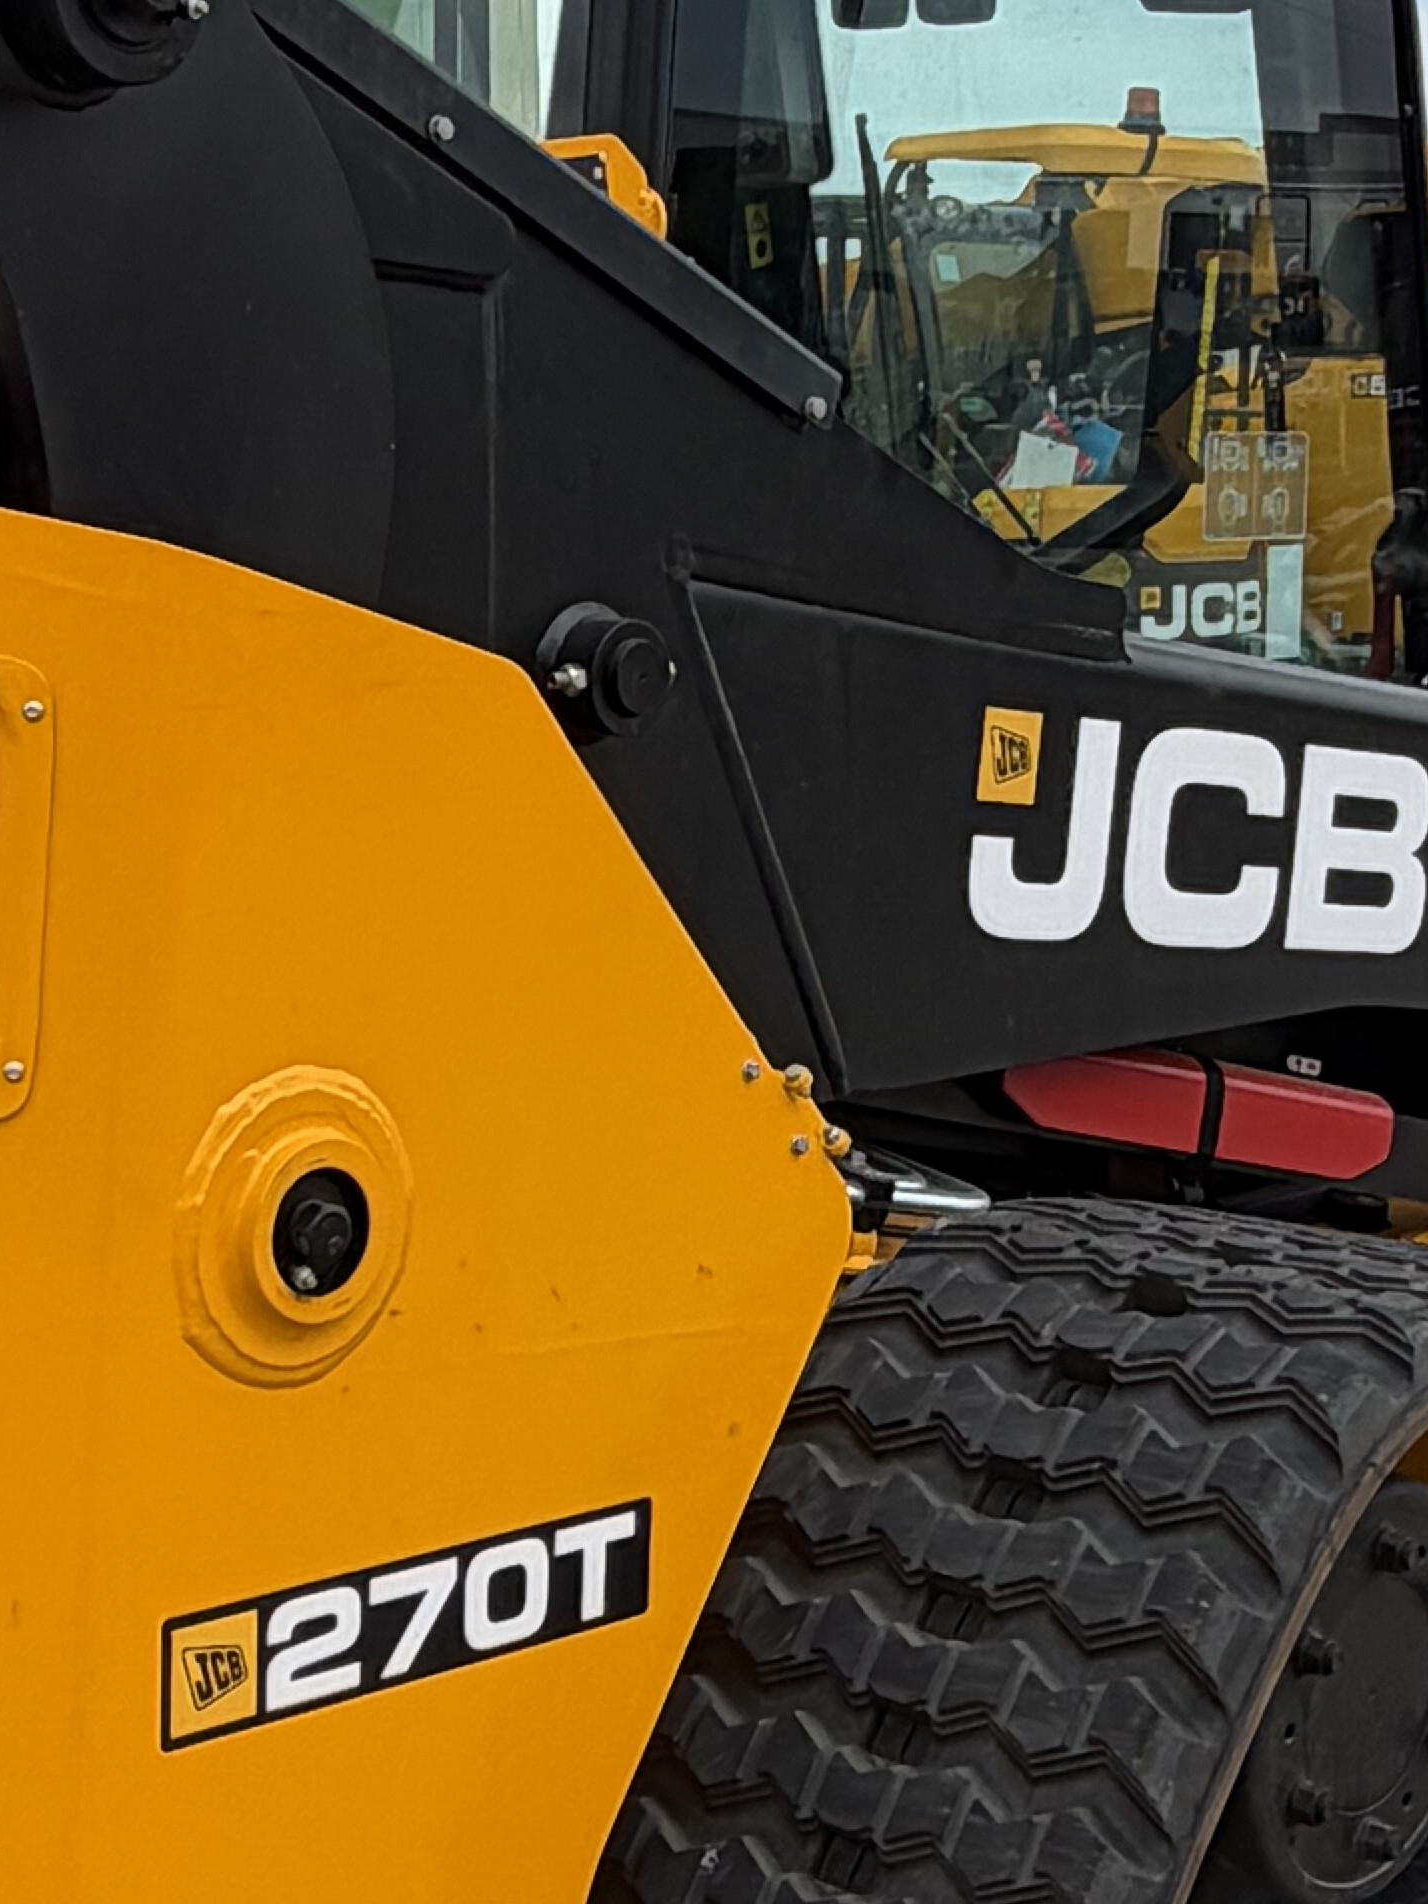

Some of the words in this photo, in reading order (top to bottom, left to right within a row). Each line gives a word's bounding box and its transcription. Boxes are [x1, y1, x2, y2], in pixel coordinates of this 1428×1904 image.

[1140, 580, 1262, 640] JCB
[194, 1650, 243, 1702] JCB
[267, 1511, 636, 1713] 270T
